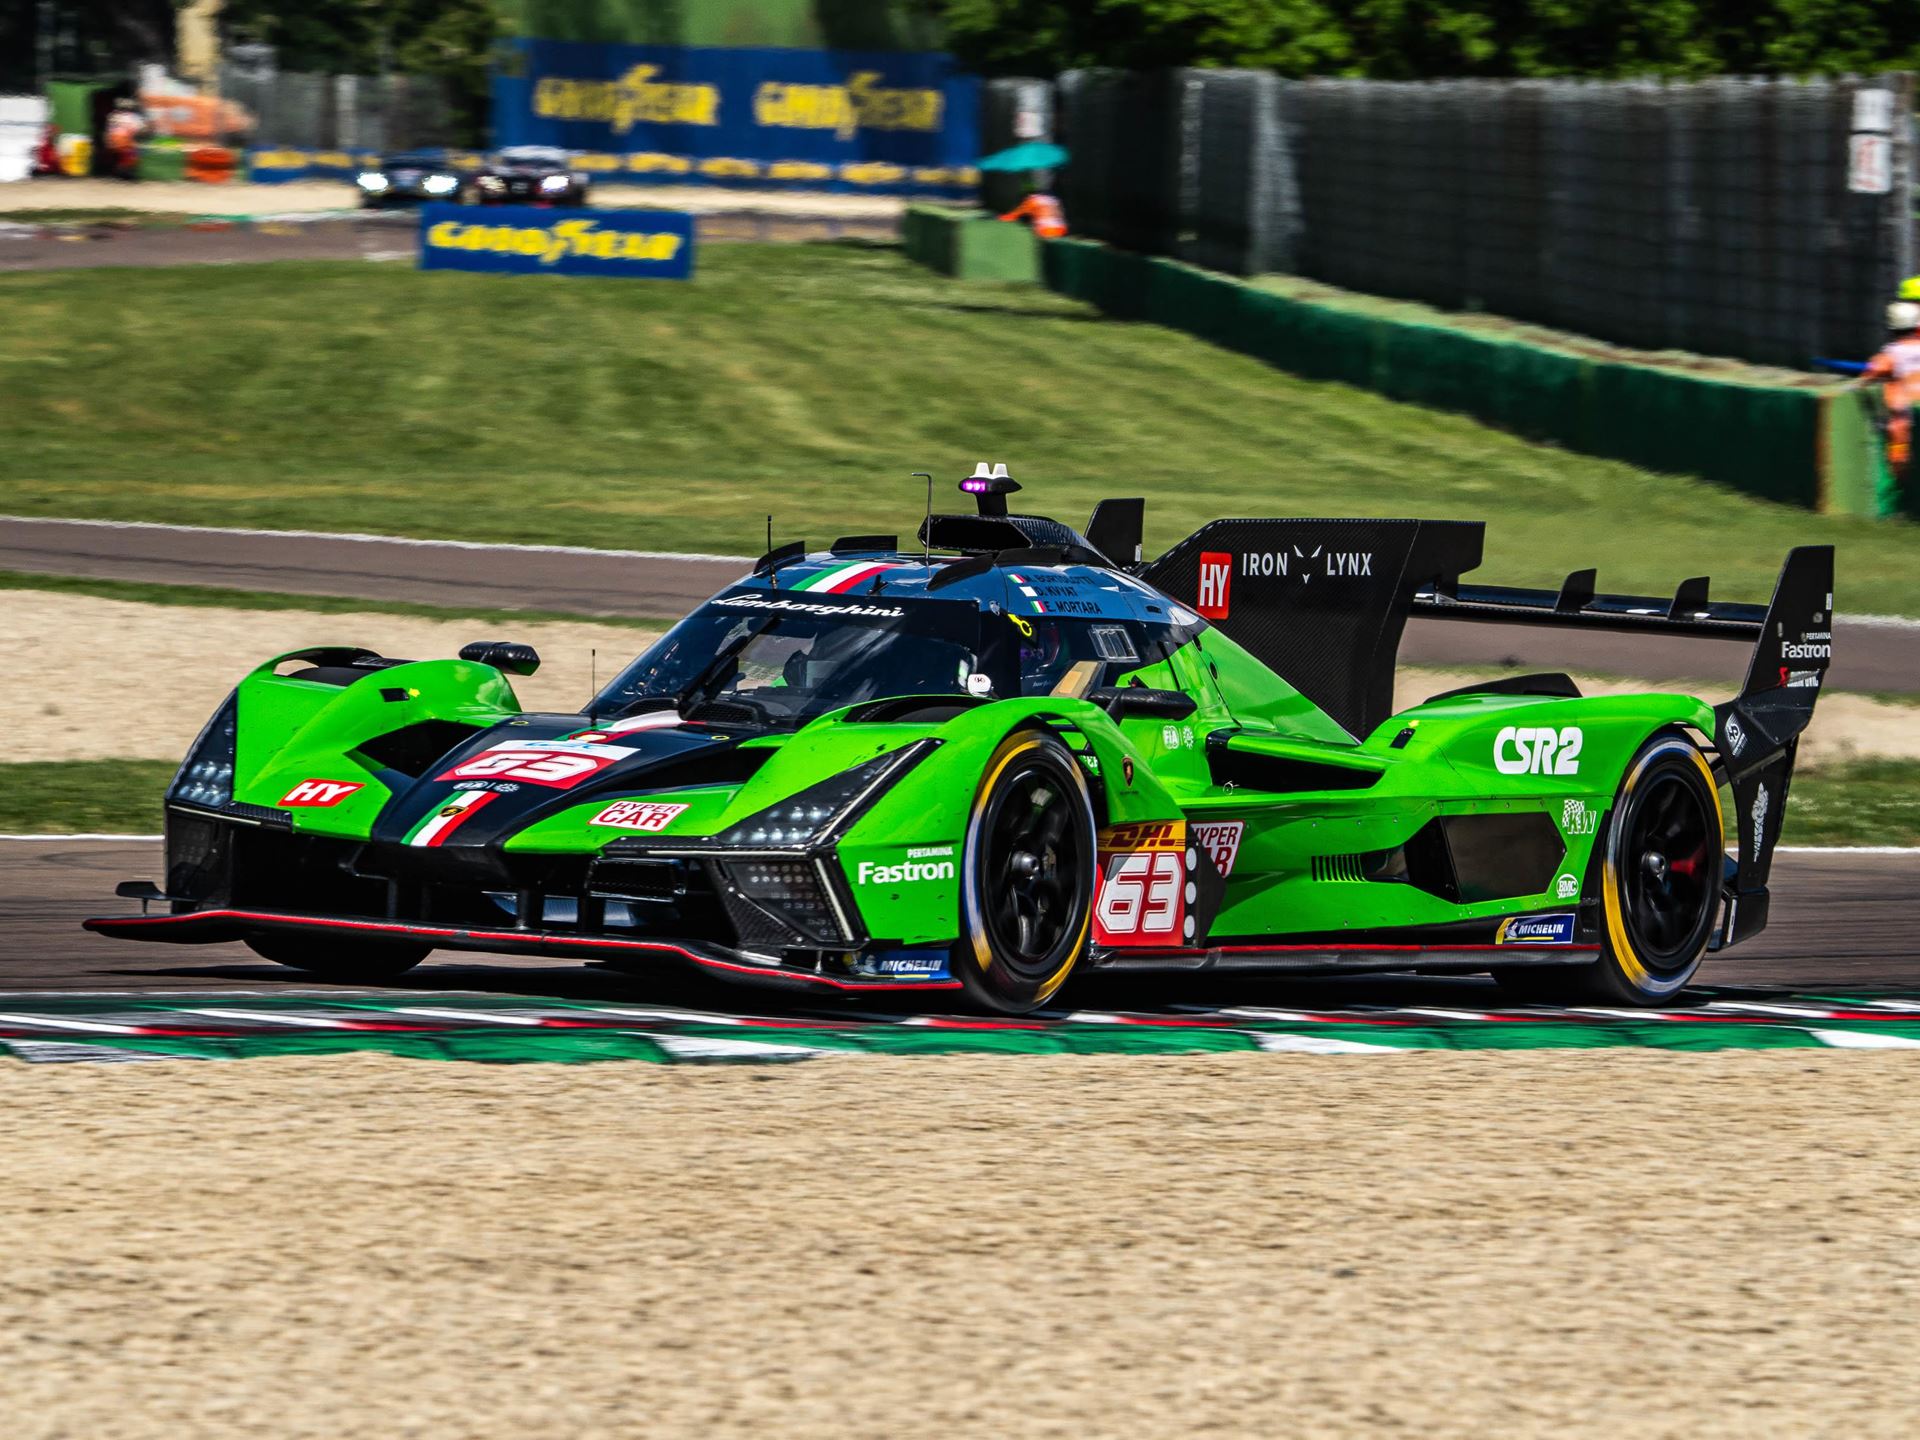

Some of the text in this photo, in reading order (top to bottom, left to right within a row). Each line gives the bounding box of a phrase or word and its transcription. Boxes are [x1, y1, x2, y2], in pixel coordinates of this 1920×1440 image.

[427, 218, 682, 264] GOODYEAR
[1242, 552, 1372, 576] IRON LYNX
[1199, 563, 1229, 607] HY
[710, 594, 904, 617] Lamborghini
[1055, 601, 1103, 614] MORTARA
[1781, 641, 1831, 658] Fastron
[1493, 726, 1583, 775] CSR2
[284, 781, 359, 802] HY
[613, 802, 680, 813] HYPER
[598, 810, 670, 828] CAR
[1567, 810, 1597, 834] KW
[1108, 824, 1176, 848] DHL
[907, 847, 953, 858] PERTAMINA
[858, 861, 954, 885] Fastron
[1096, 853, 1182, 933] 63
[1559, 880, 1577, 892] BMC
[1518, 923, 1564, 934] MICHELIN
[880, 959, 943, 972] MICHELIN
